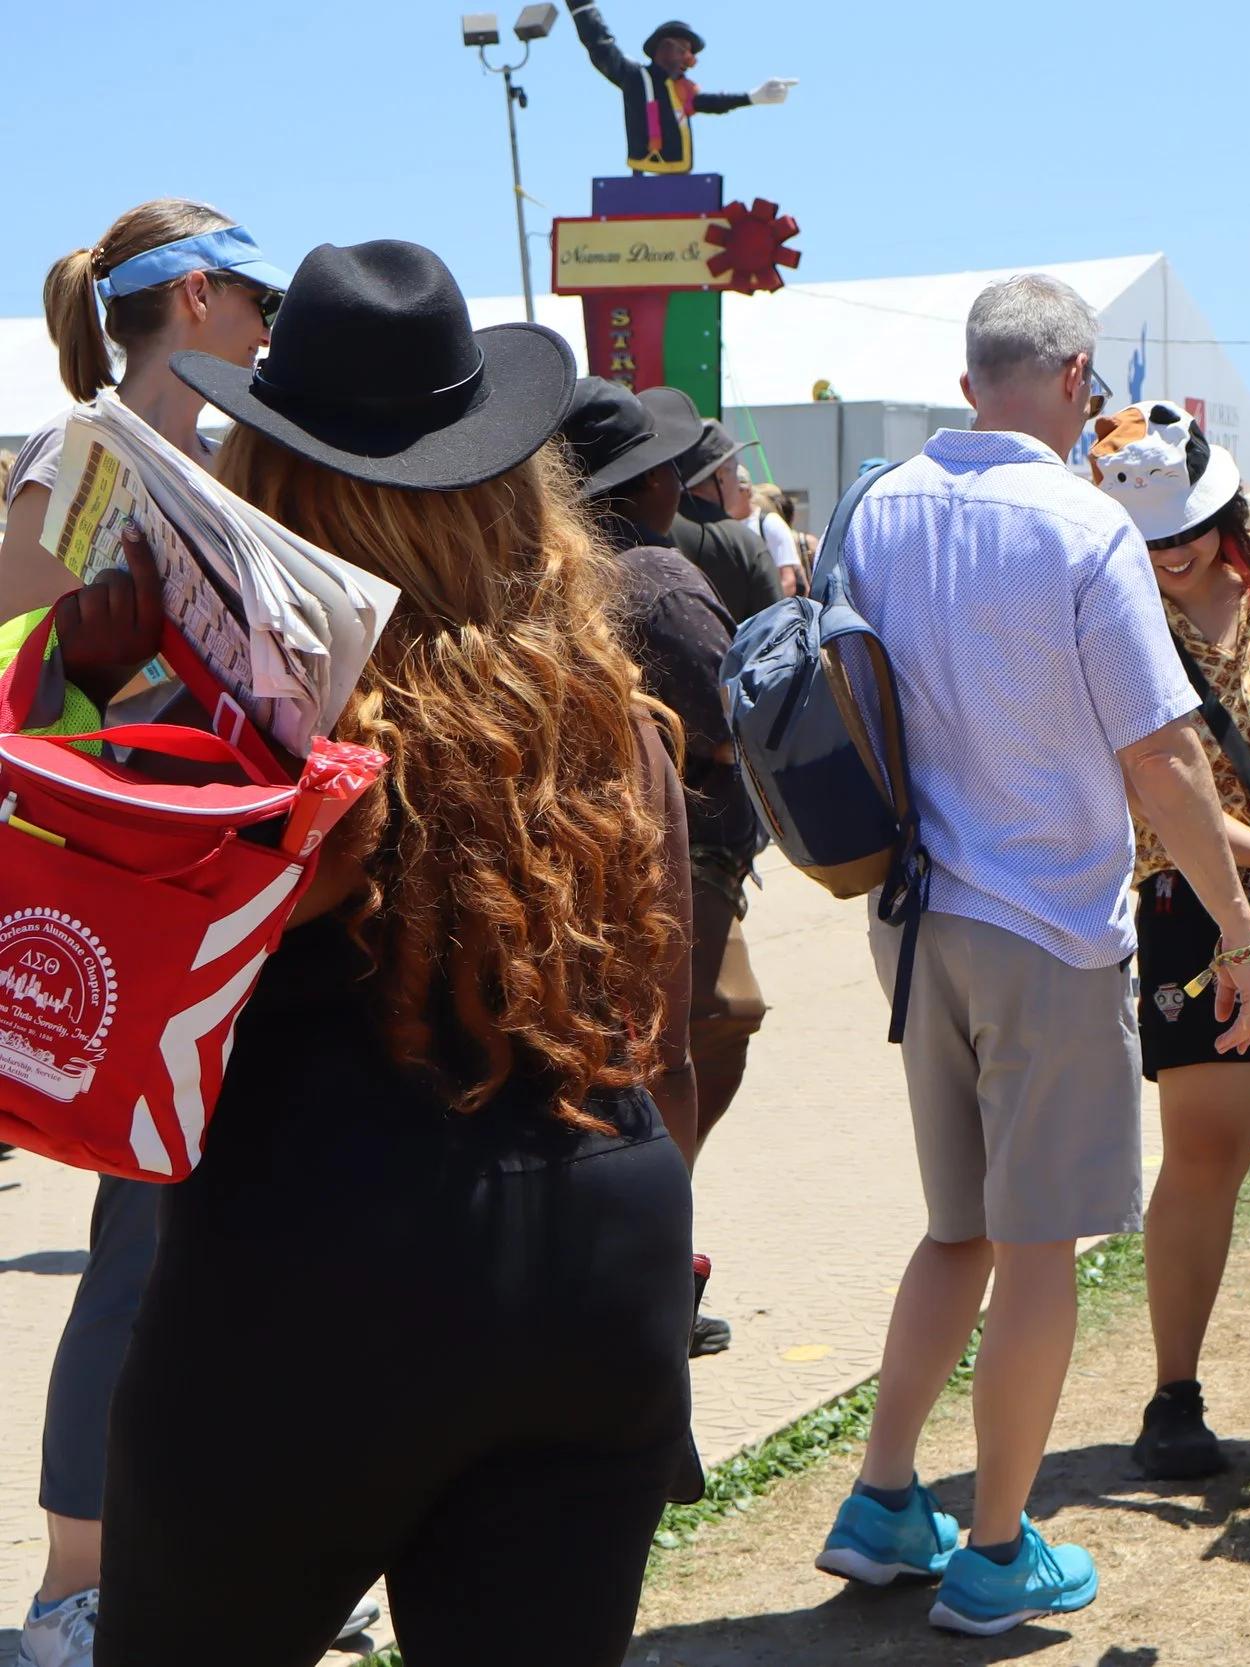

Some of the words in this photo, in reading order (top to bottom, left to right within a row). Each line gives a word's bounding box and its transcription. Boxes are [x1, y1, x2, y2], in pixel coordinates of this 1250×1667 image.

[0, 923, 41, 943] Orleans
[42, 922, 86, 957] Alumnae
[83, 956, 101, 1007] Chapter
